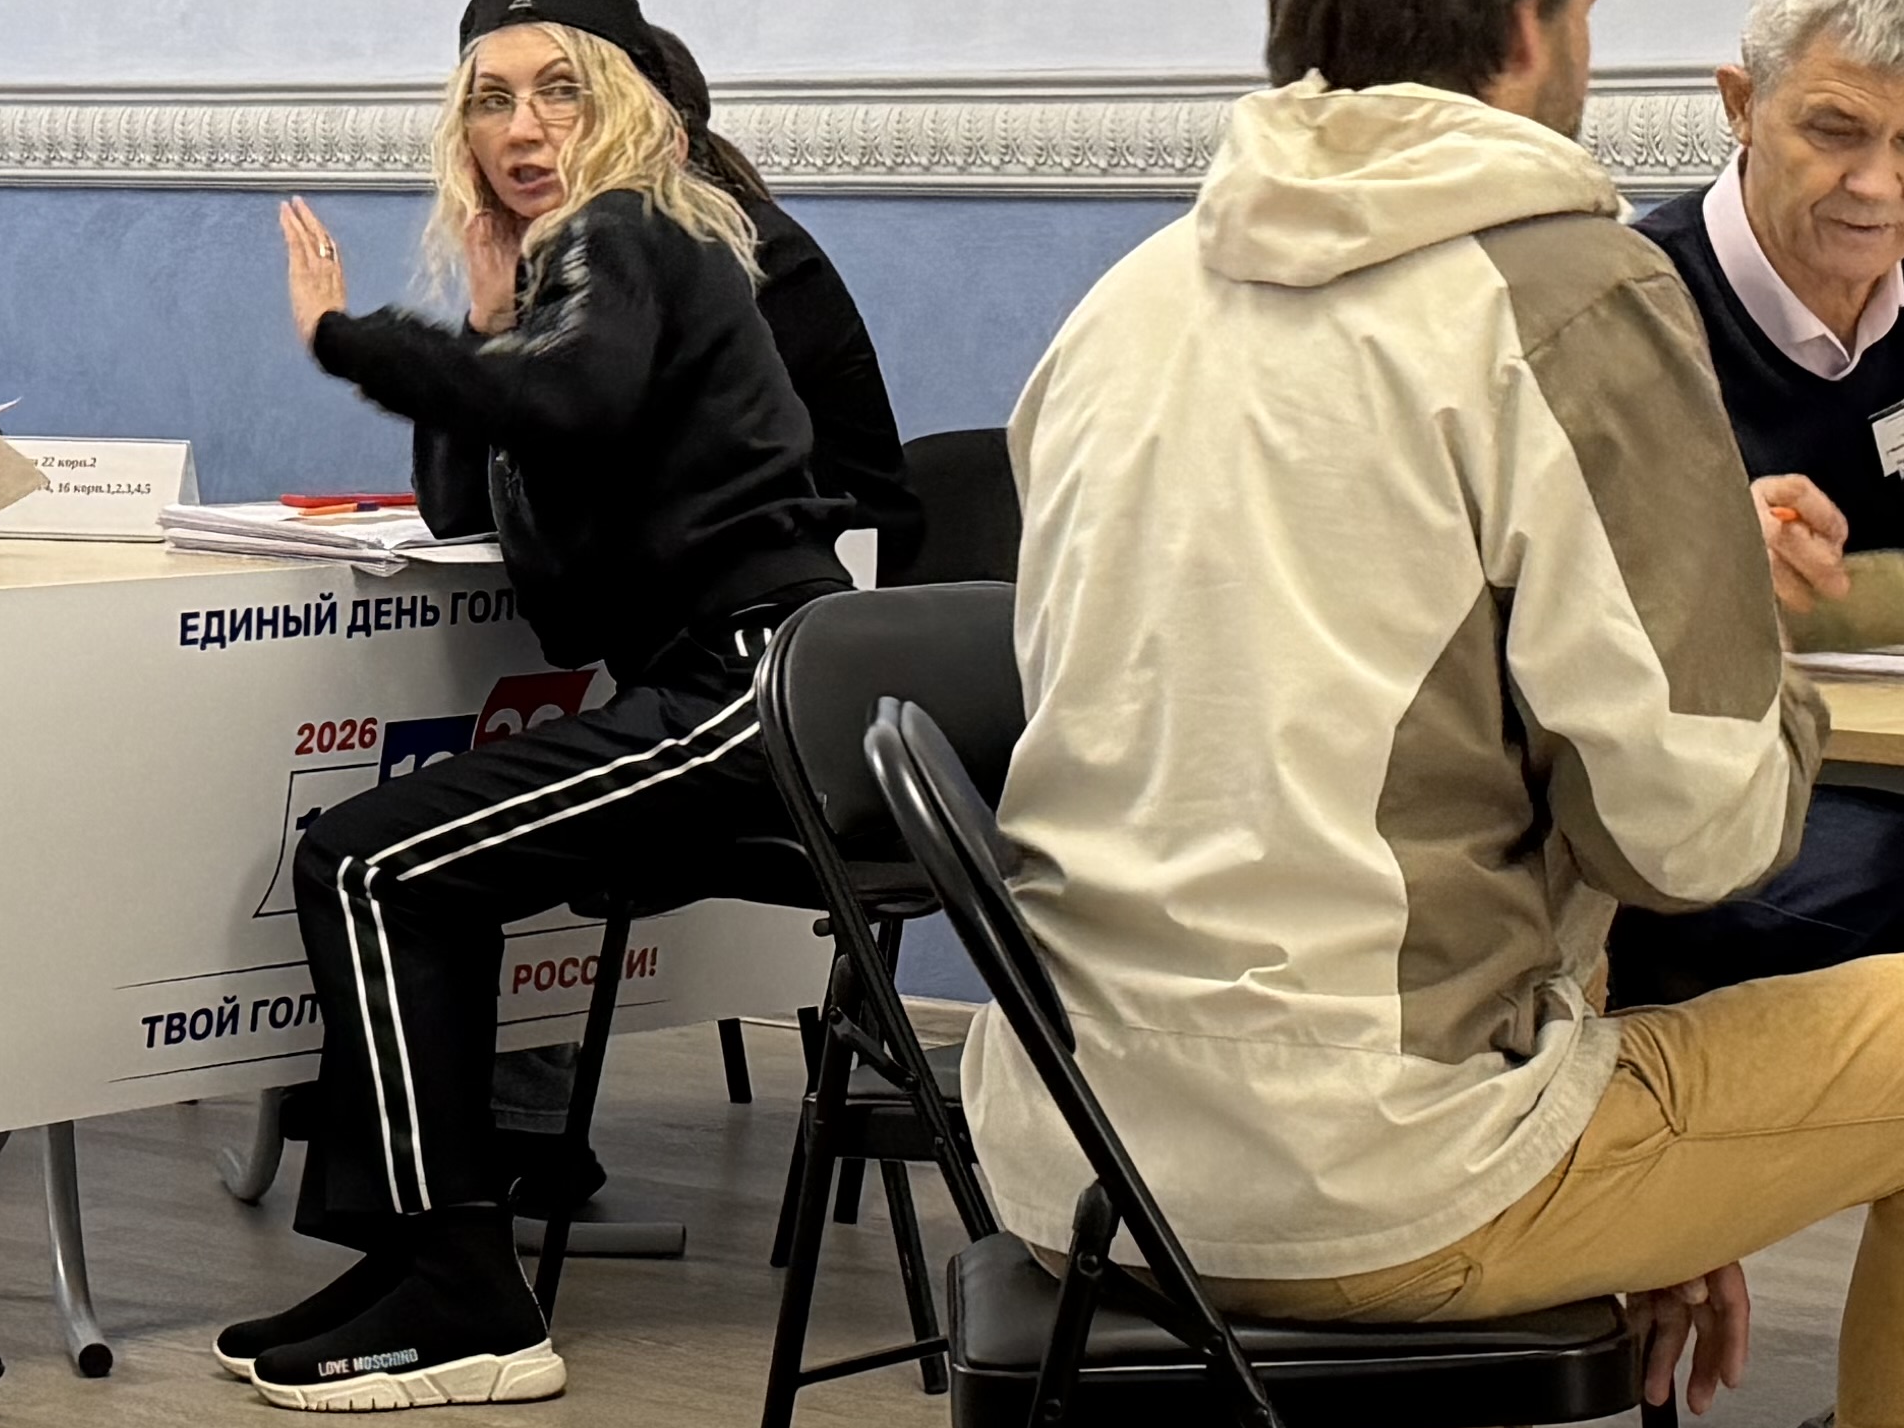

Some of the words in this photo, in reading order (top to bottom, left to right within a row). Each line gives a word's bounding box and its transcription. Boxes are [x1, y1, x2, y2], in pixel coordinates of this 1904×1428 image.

[41, 456, 56, 468] 22
[57, 457, 97, 470] корп.2
[58, 482, 71, 493] 16
[180, 592, 338, 651] ЕДИНЫЙ
[346, 594, 441, 638] ДЕНЬ
[450, 588, 515, 625] ГОЛ
[295, 717, 378, 756] 2026
[141, 995, 241, 1049] ТВОЙ
[250, 993, 317, 1033] ГОЛ
[512, 946, 659, 995] РОССИ!
[318, 1358, 351, 1377] LOVE
[353, 1348, 419, 1372] MOSCHINO
